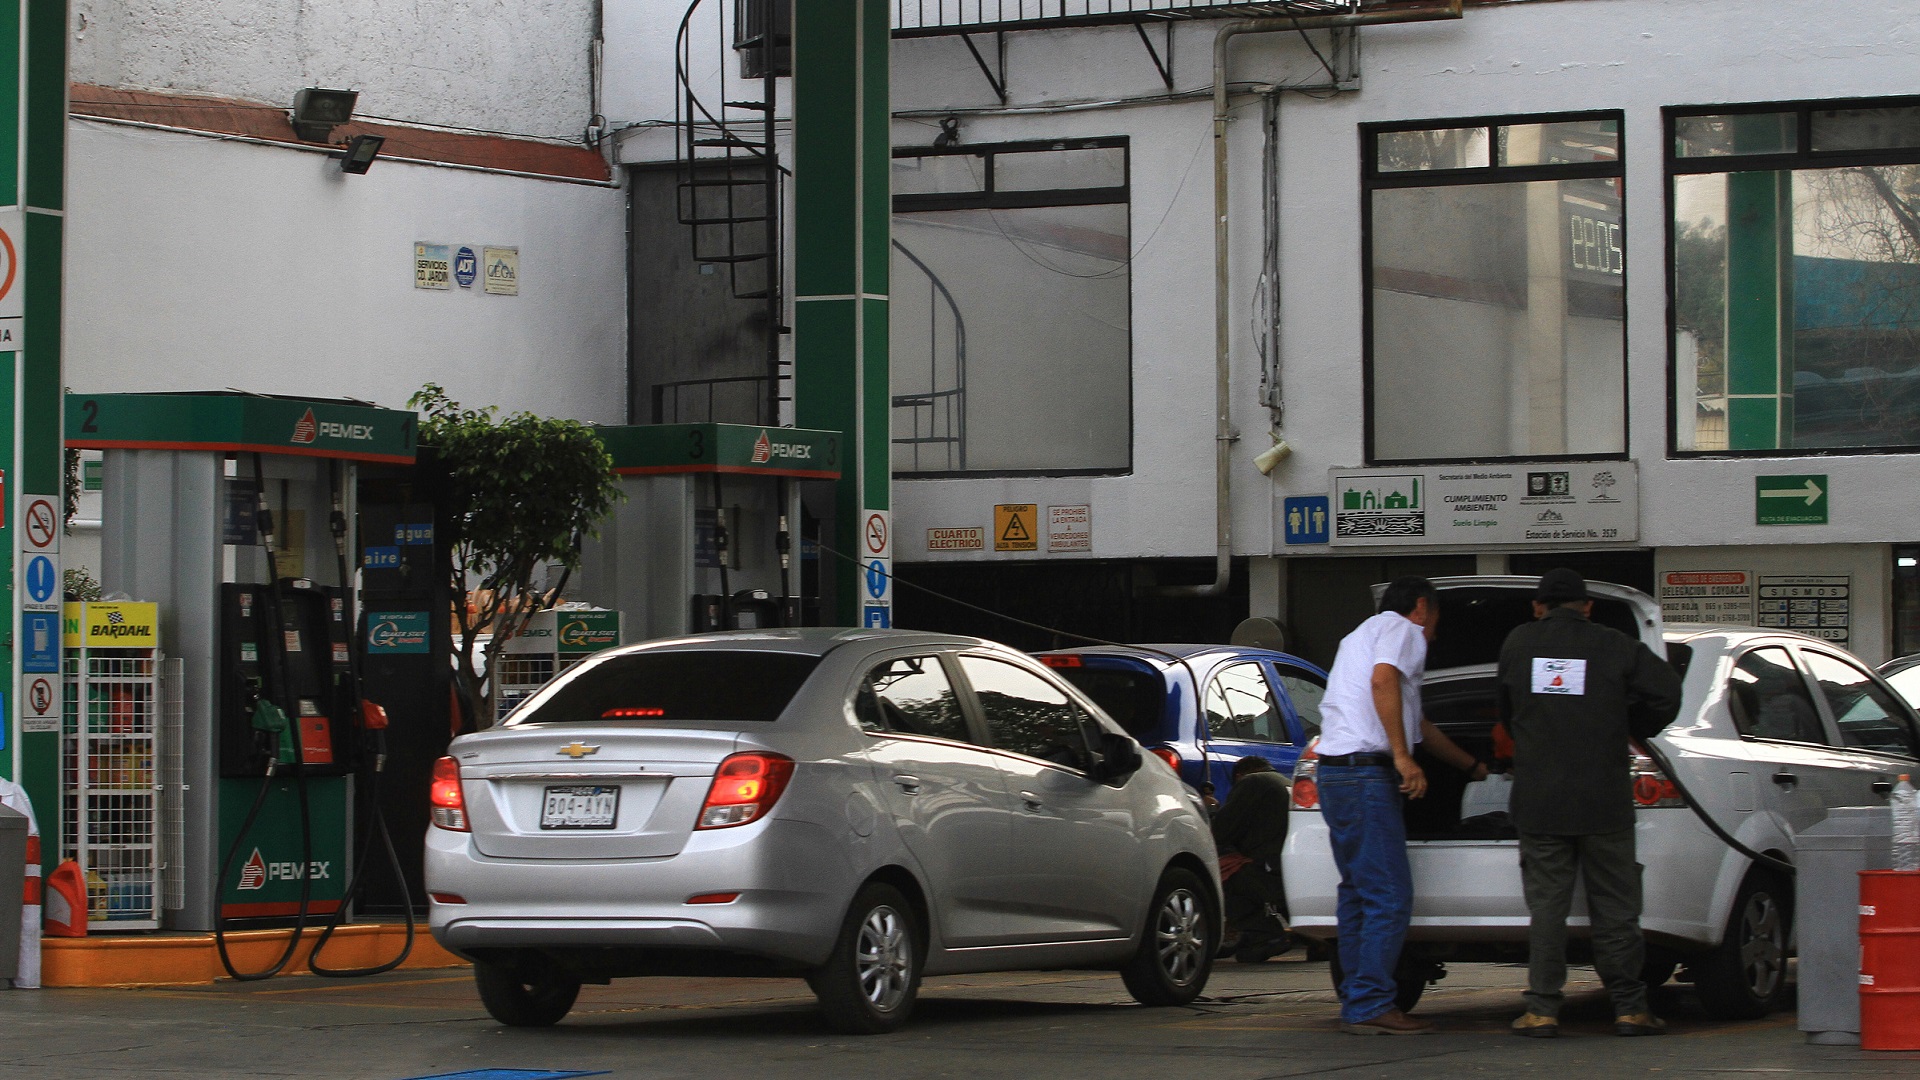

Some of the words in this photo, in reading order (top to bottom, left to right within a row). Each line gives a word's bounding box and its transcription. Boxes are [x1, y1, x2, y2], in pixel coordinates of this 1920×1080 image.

[417, 260, 448, 271] SERVICIOS
[457, 259, 475, 273] ADT
[81, 400, 98, 433] 2
[319, 421, 374, 440] PEMEX
[401, 418, 411, 449] 1
[688, 430, 704, 459] 3
[771, 443, 811, 459] PEMEX
[1443, 494, 1508, 503] CUMPLIMIENTO
[1061, 507, 1086, 515] PROHIBE
[1454, 503, 1498, 512] AMBIENTAL
[1060, 516, 1087, 524] ENTRADA
[1453, 519, 1472, 527] Suelo
[1473, 519, 1498, 528] Limpio
[395, 529, 432, 542] agua
[934, 529, 977, 539] CUARTO
[1050, 531, 1088, 539] VENDEDORES
[1526, 529, 1552, 539] Estación
[1553, 530, 1560, 538] de
[1561, 529, 1586, 539] Servicio
[1587, 529, 1598, 537] No.
[929, 538, 981, 549] ELECTRICO
[1050, 540, 1088, 548] AMBULANTES
[365, 551, 397, 565] aire
[1711, 586, 1750, 595] COYOACAN
[1771, 588, 1838, 596] SISMOS
[1662, 603, 1679, 611] CRUZ
[1789, 602, 1796, 610] 2
[1662, 614, 1699, 623] BOMBEROS
[1790, 616, 1796, 624] 5
[90, 625, 152, 640] BARDAHL
[548, 797, 613, 815] B04-AYN
[268, 861, 330, 881] PEMEX
